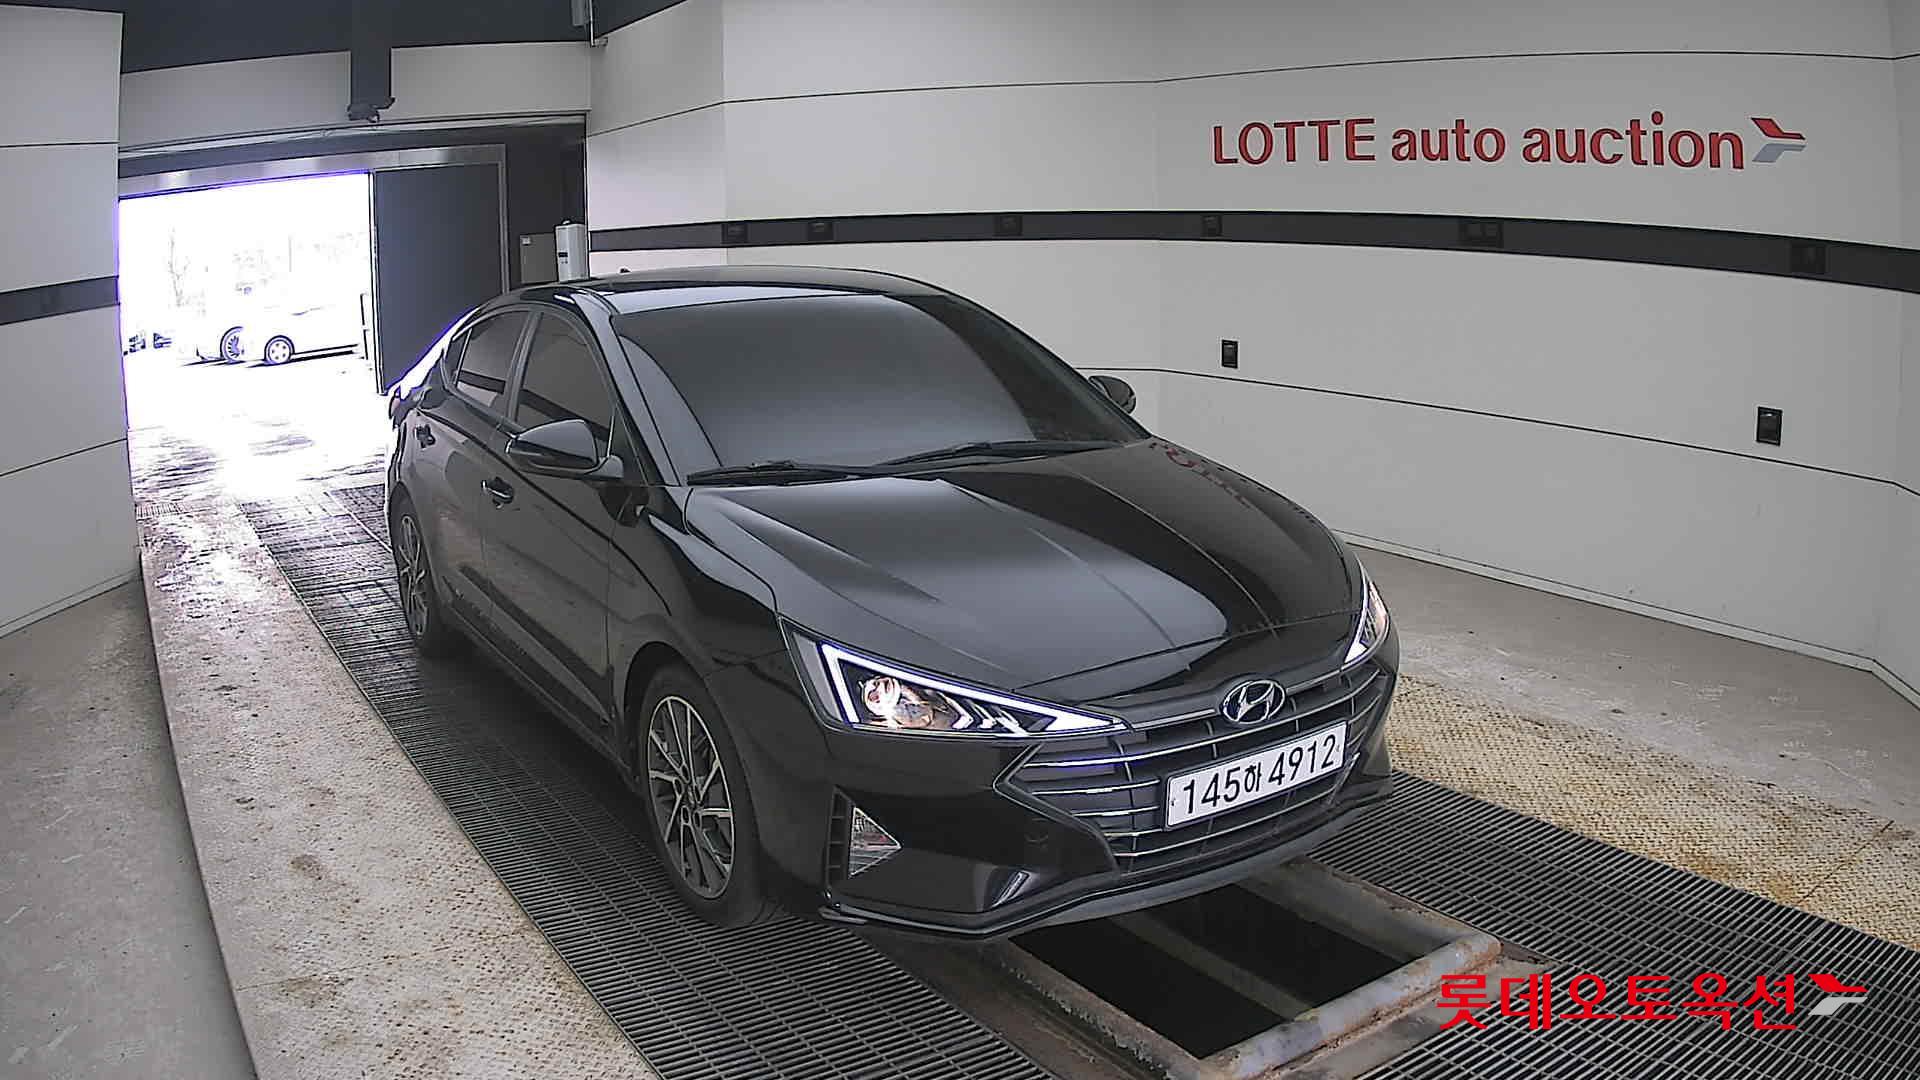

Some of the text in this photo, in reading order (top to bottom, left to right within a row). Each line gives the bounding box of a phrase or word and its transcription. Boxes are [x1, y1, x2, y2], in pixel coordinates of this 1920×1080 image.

[1213, 110, 1745, 170] LOTTE auto auction
[1183, 734, 1336, 814] 145하 4912
